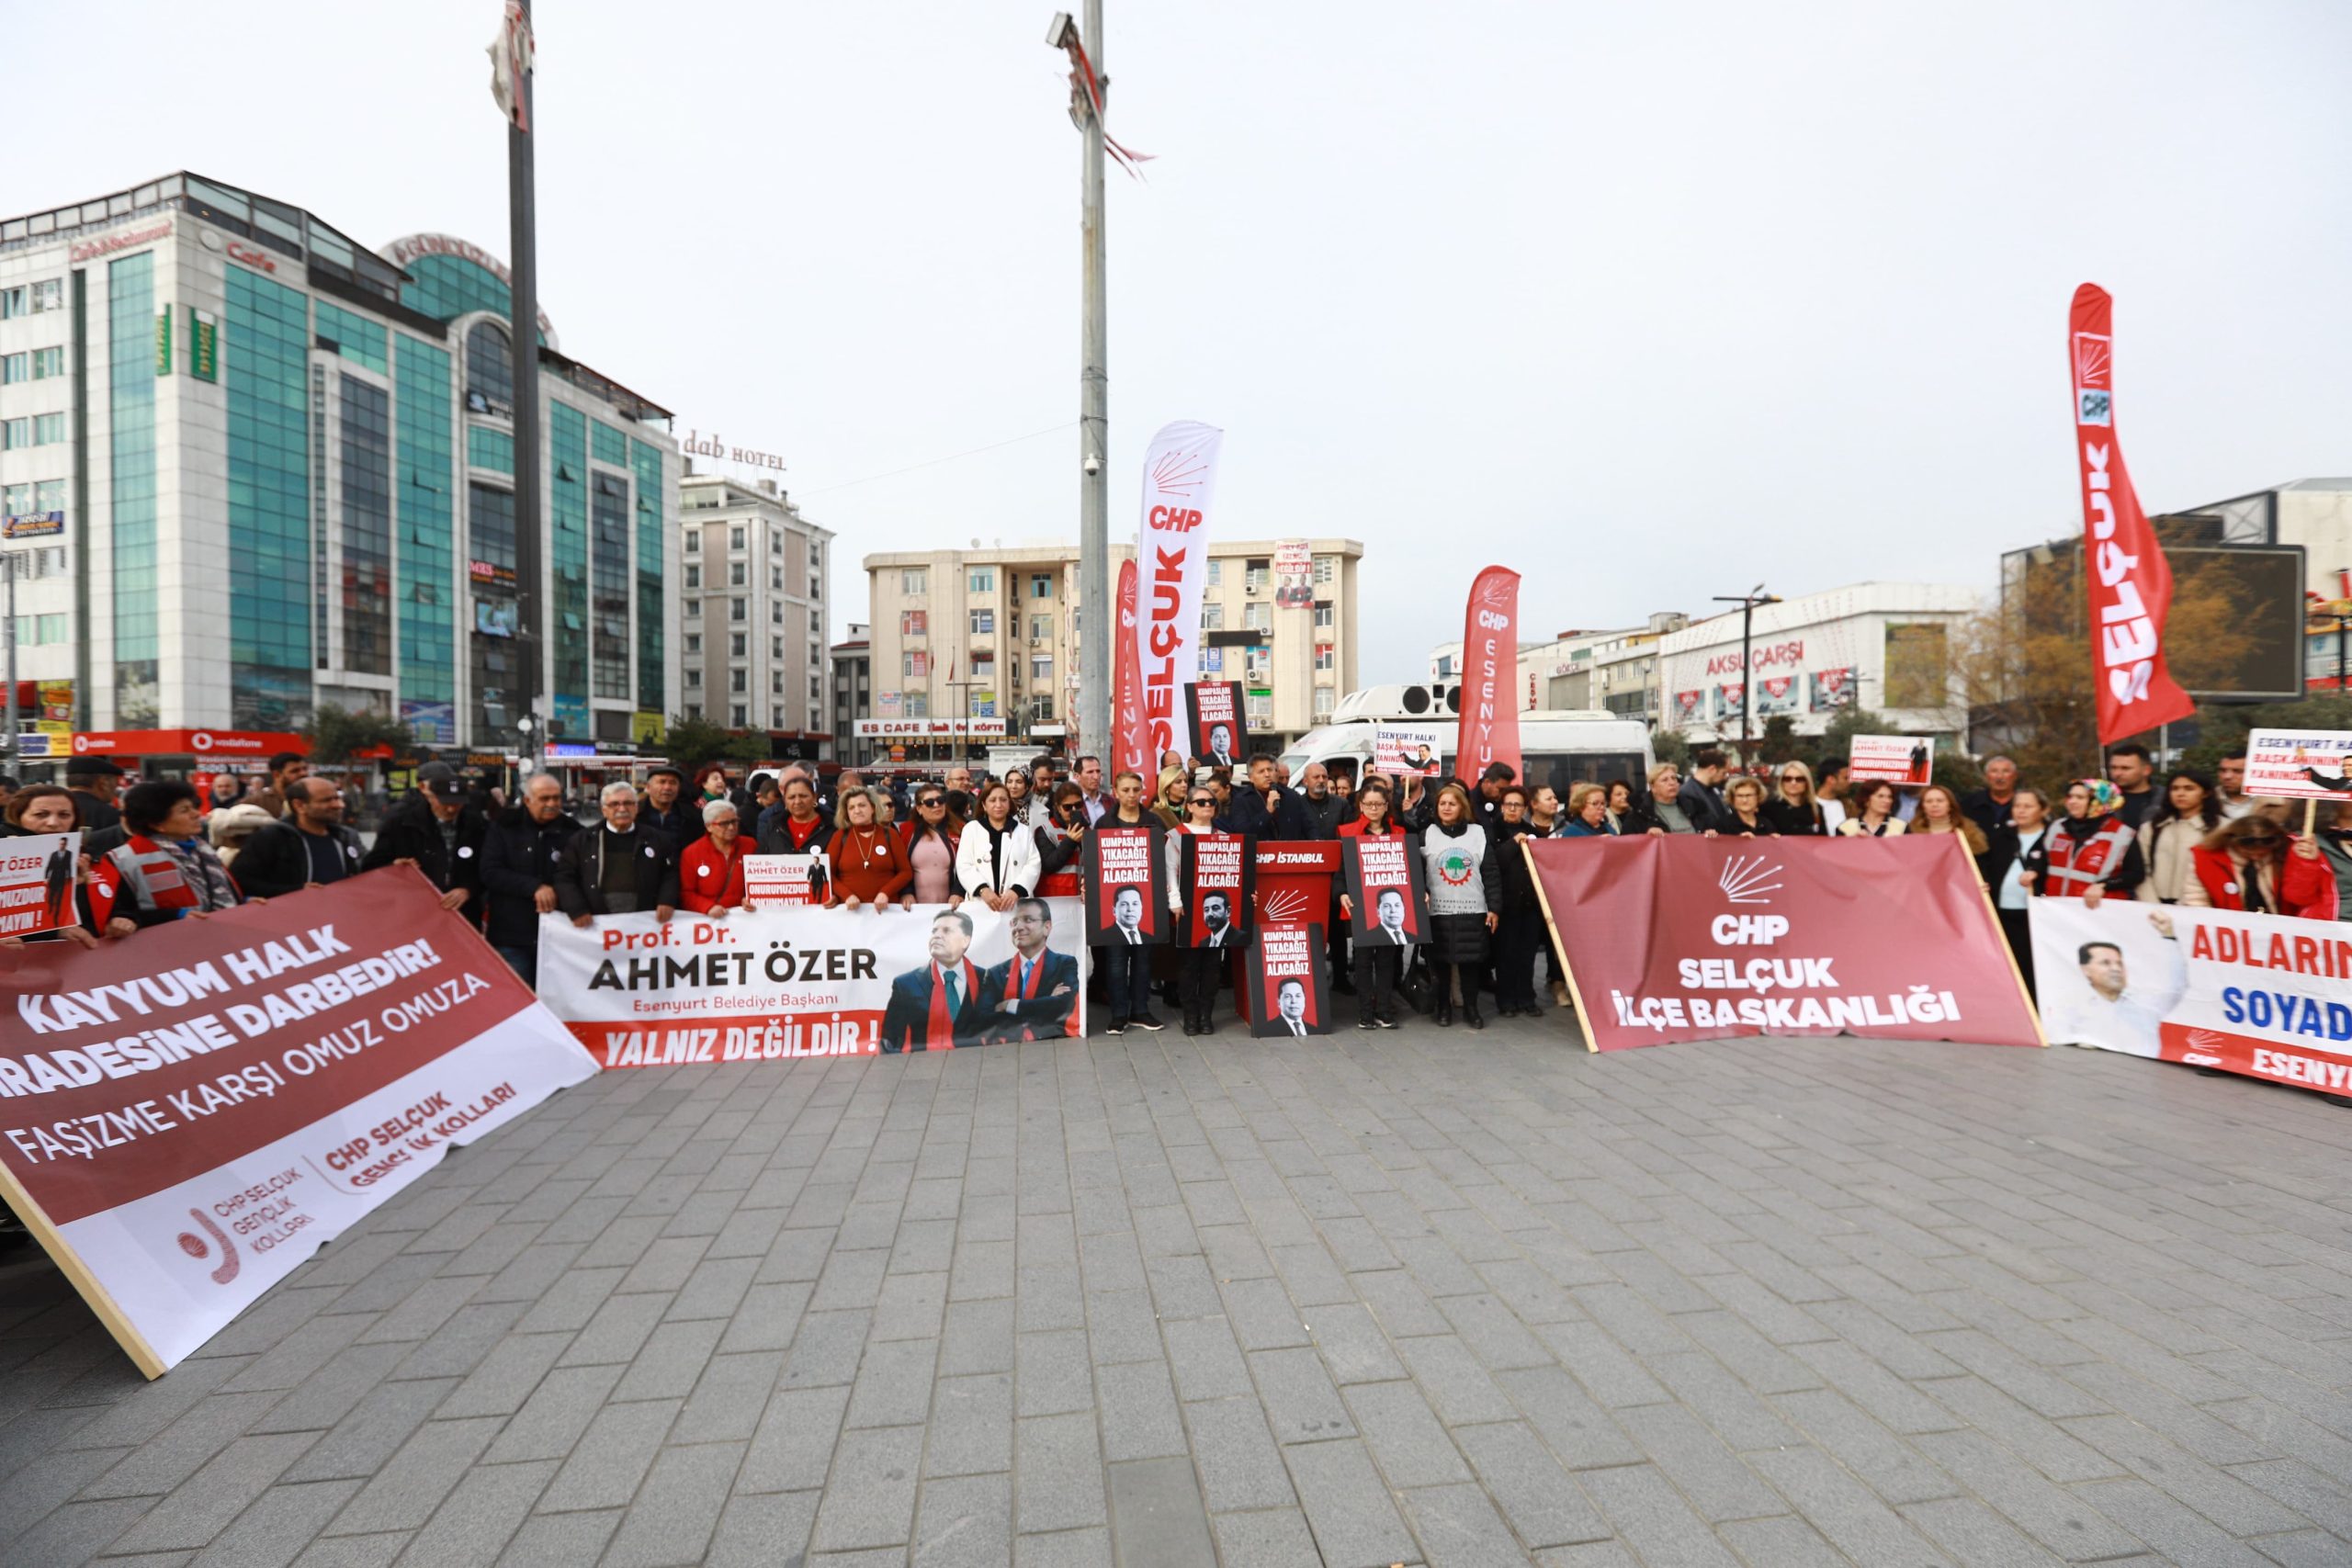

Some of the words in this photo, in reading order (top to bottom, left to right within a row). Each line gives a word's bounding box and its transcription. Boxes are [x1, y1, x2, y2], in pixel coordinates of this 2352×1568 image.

[227, 242, 276, 273] Cafe
[684, 429, 724, 458] dab
[732, 446, 786, 471] HOTEL
[1149, 505, 1203, 533] CHP
[2086, 442, 2158, 706] SELÇUK
[1478, 610, 1509, 631] CHP
[1147, 544, 1186, 752] SELÇUK
[862, 723, 879, 733] ES
[884, 723, 920, 733] CAFE
[974, 722, 1004, 732] KÖFTE
[1377, 731, 1413, 741] ESENYURT
[1415, 734, 1436, 742] HALKI
[1101, 837, 1147, 848] KUMPASLARI
[1197, 841, 1240, 852] KUMPASLARI
[1359, 841, 1403, 852] KUMPASLARI
[8, 855, 43, 871] ÖZER
[1102, 846, 1148, 861] YIKACAĞIZ
[1198, 851, 1239, 865] YIKACAĞIZ
[1277, 851, 1324, 863] İSTANBUL
[1362, 851, 1405, 865] YIKACAĞIZ
[747, 866, 779, 874] AHMET
[780, 865, 804, 874] ÖZER
[1102, 868, 1148, 884] ALACAĞIZ
[1197, 873, 1239, 887] ALACAĞIZ
[1364, 872, 1408, 886] ALACAĞIZ
[603, 926, 681, 952] Prof.
[694, 922, 737, 946] Dr.
[1263, 931, 1306, 942] KUMPASLARI
[1711, 913, 1790, 946] CHP
[1264, 940, 1307, 953] YIKACAĞIZ
[587, 951, 754, 991] AHMET
[763, 941, 878, 983] ÖZER
[1267, 961, 1309, 976] ALACAĞIZ
[1678, 956, 1839, 995] SELÇUK
[18, 964, 230, 1034] KAYYUM
[221, 923, 352, 984] HALK
[226, 937, 443, 1039] DARBEDİR!
[633, 995, 707, 1014] Esenyurt
[713, 993, 776, 1012] Belediye
[781, 992, 839, 1011] Başkanı
[1611, 989, 1689, 1032] İLÇE
[605, 1027, 717, 1066] YALNIZ
[720, 1013, 859, 1059] DEĞİLDİR
[866, 1020, 878, 1052] !
[3, 1100, 179, 1164] FAŞİZME
[166, 1059, 286, 1122] KARŞI
[282, 1021, 383, 1077] OMUZ
[380, 972, 490, 1032] OMUZA
[432, 1081, 516, 1138] KOLLARI
[325, 1136, 370, 1171] CHP
[369, 1090, 452, 1146] SELÇUK
[213, 1194, 247, 1217] CHP
